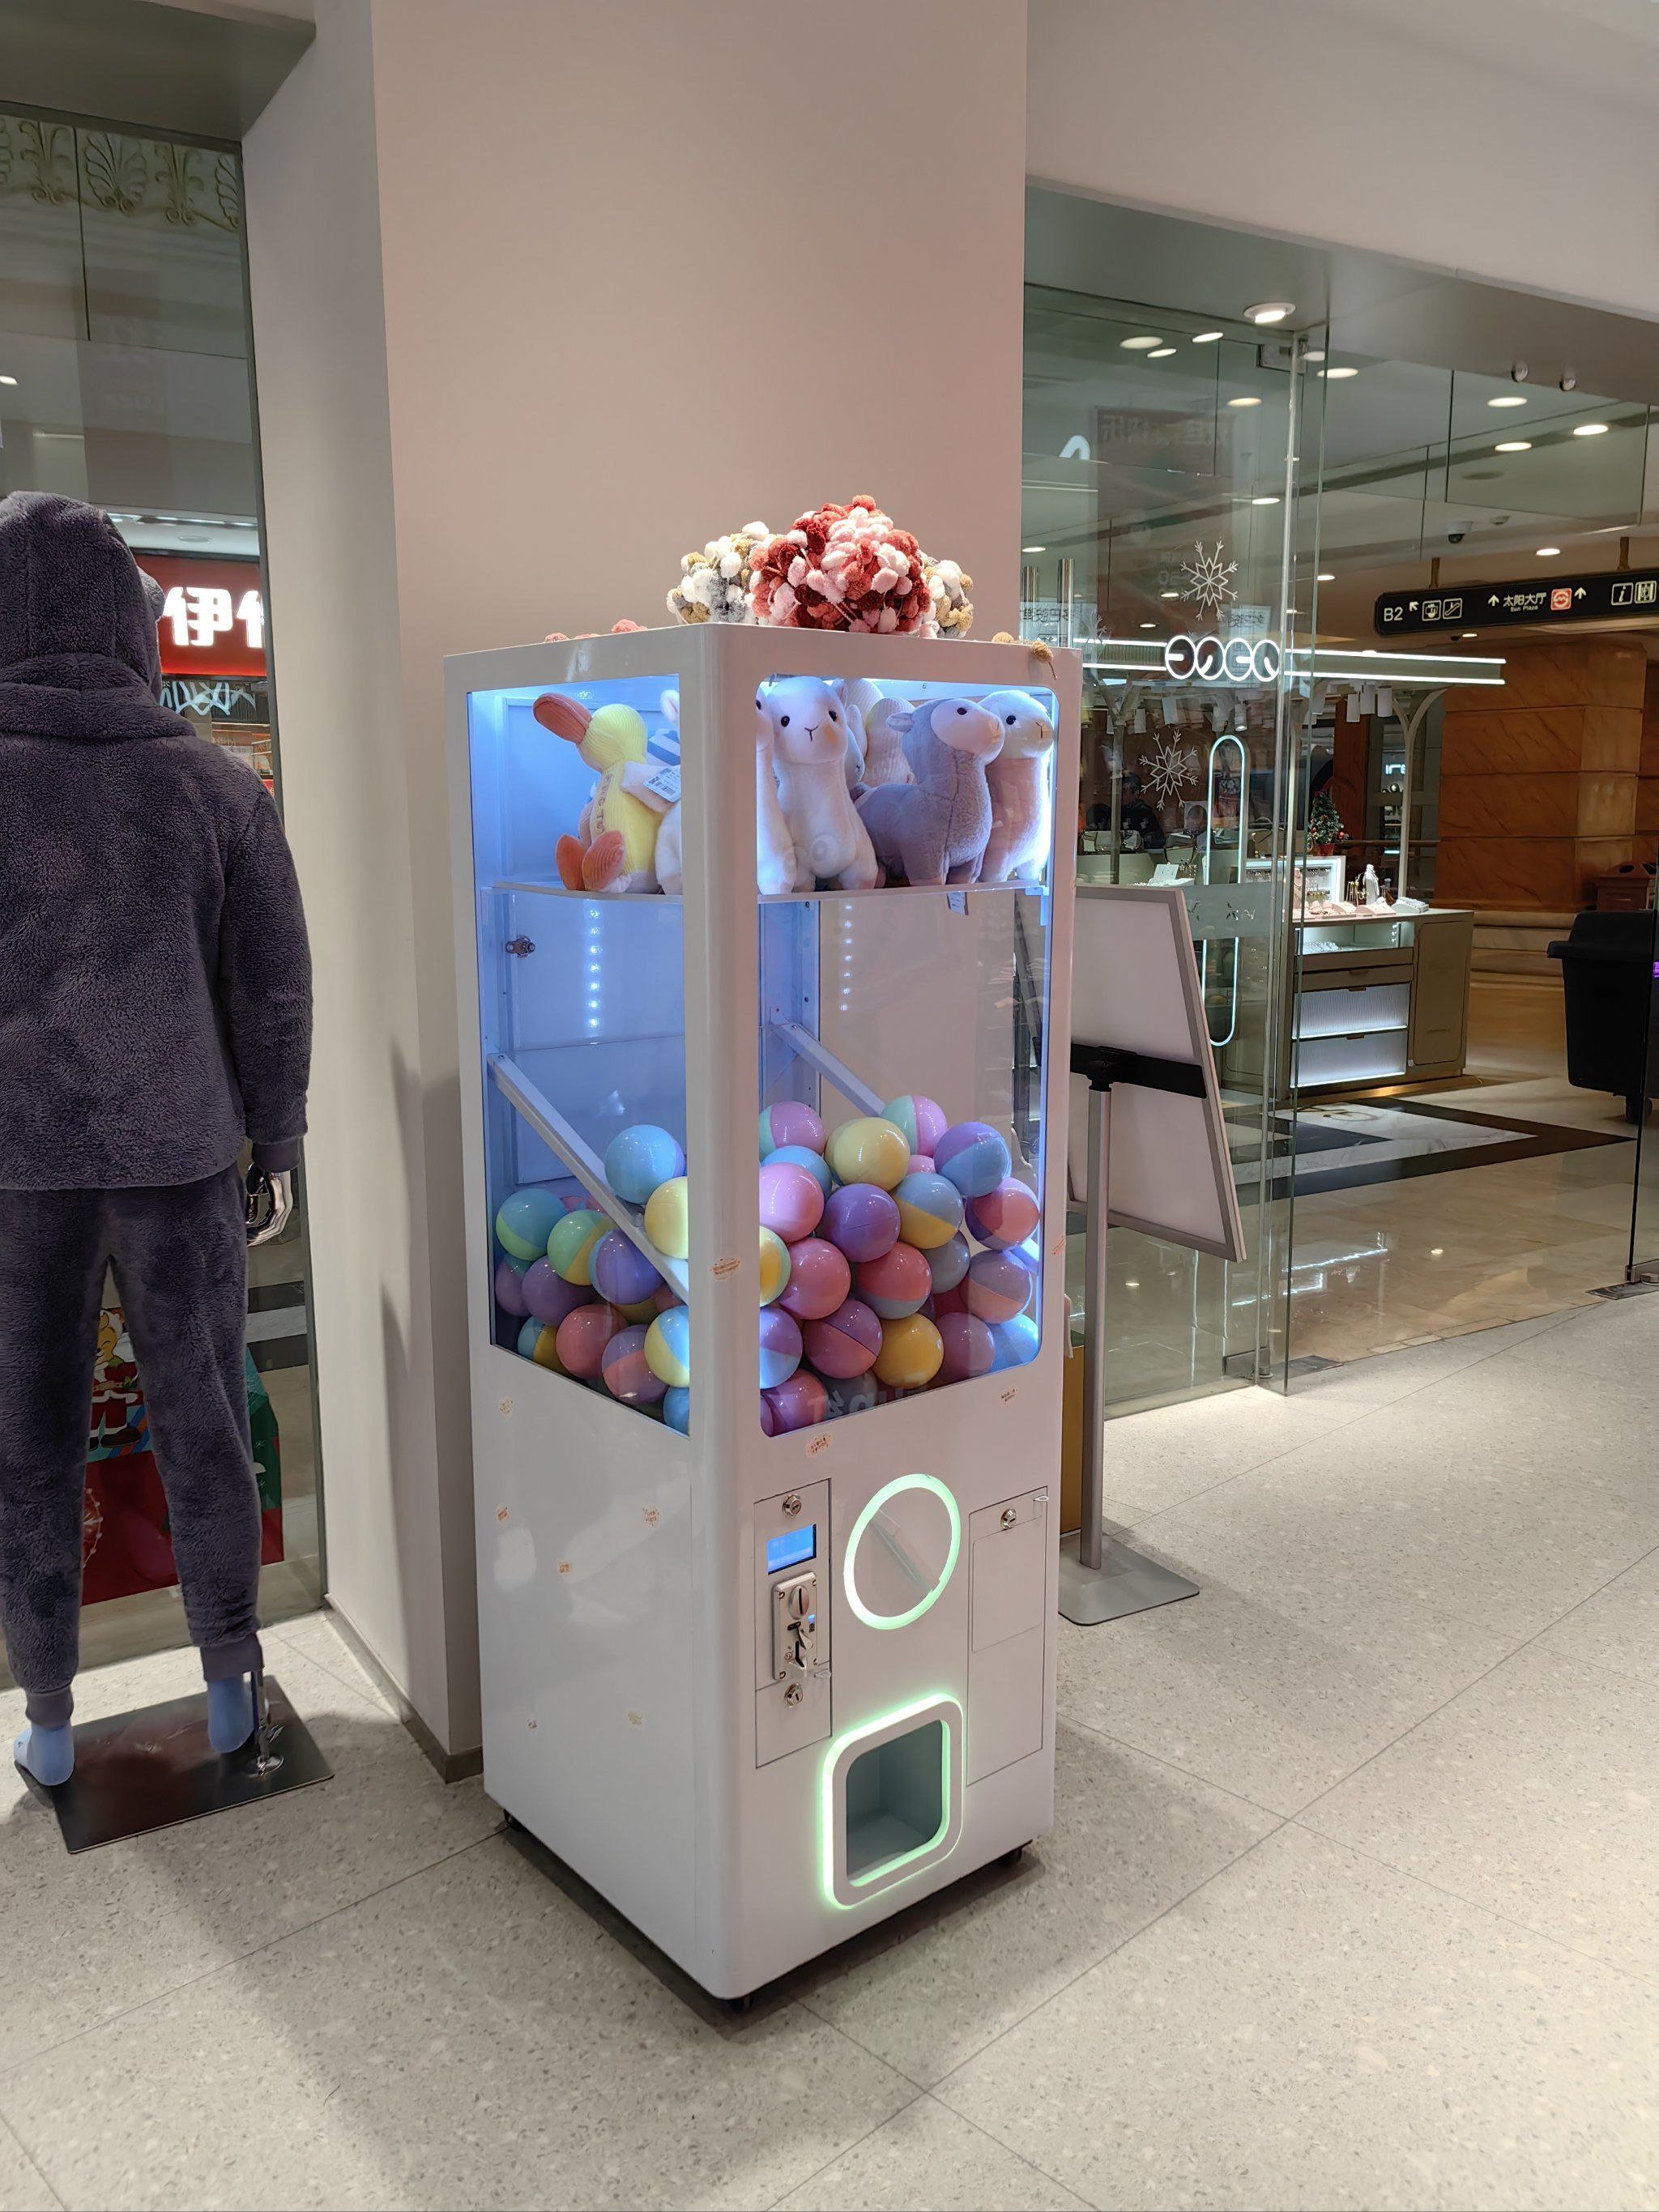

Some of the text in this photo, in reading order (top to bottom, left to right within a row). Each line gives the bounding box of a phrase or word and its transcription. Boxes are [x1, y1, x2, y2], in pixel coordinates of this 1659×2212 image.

[1503, 592, 1547, 607] 太阳大厅
[1384, 607, 1403, 622] B2
